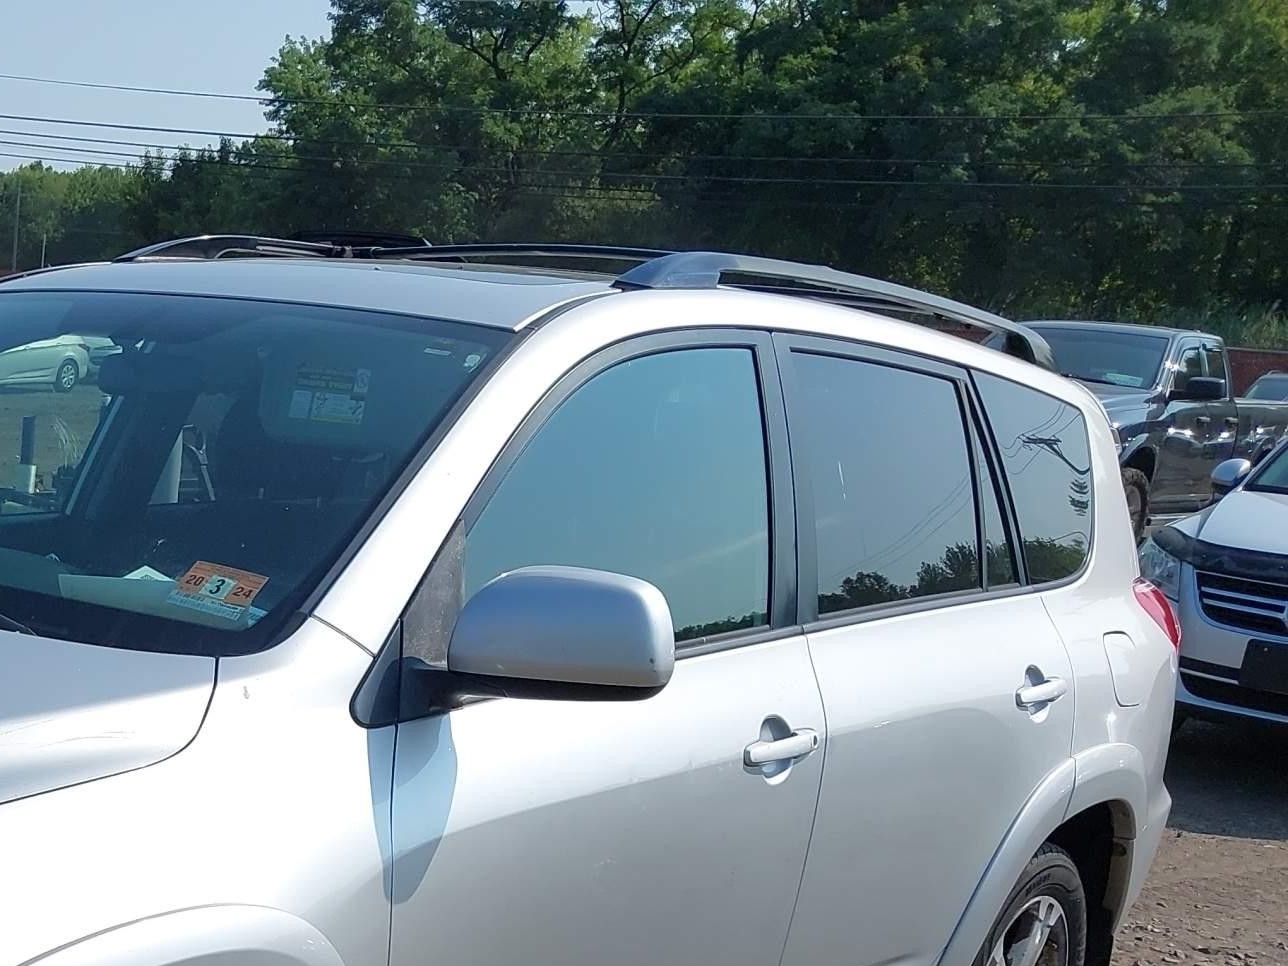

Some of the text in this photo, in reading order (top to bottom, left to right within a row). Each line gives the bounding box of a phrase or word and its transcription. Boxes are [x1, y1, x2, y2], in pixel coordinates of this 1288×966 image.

[185, 574, 205, 587] 20
[209, 579, 225, 595] 3
[232, 586, 253, 599] 24
